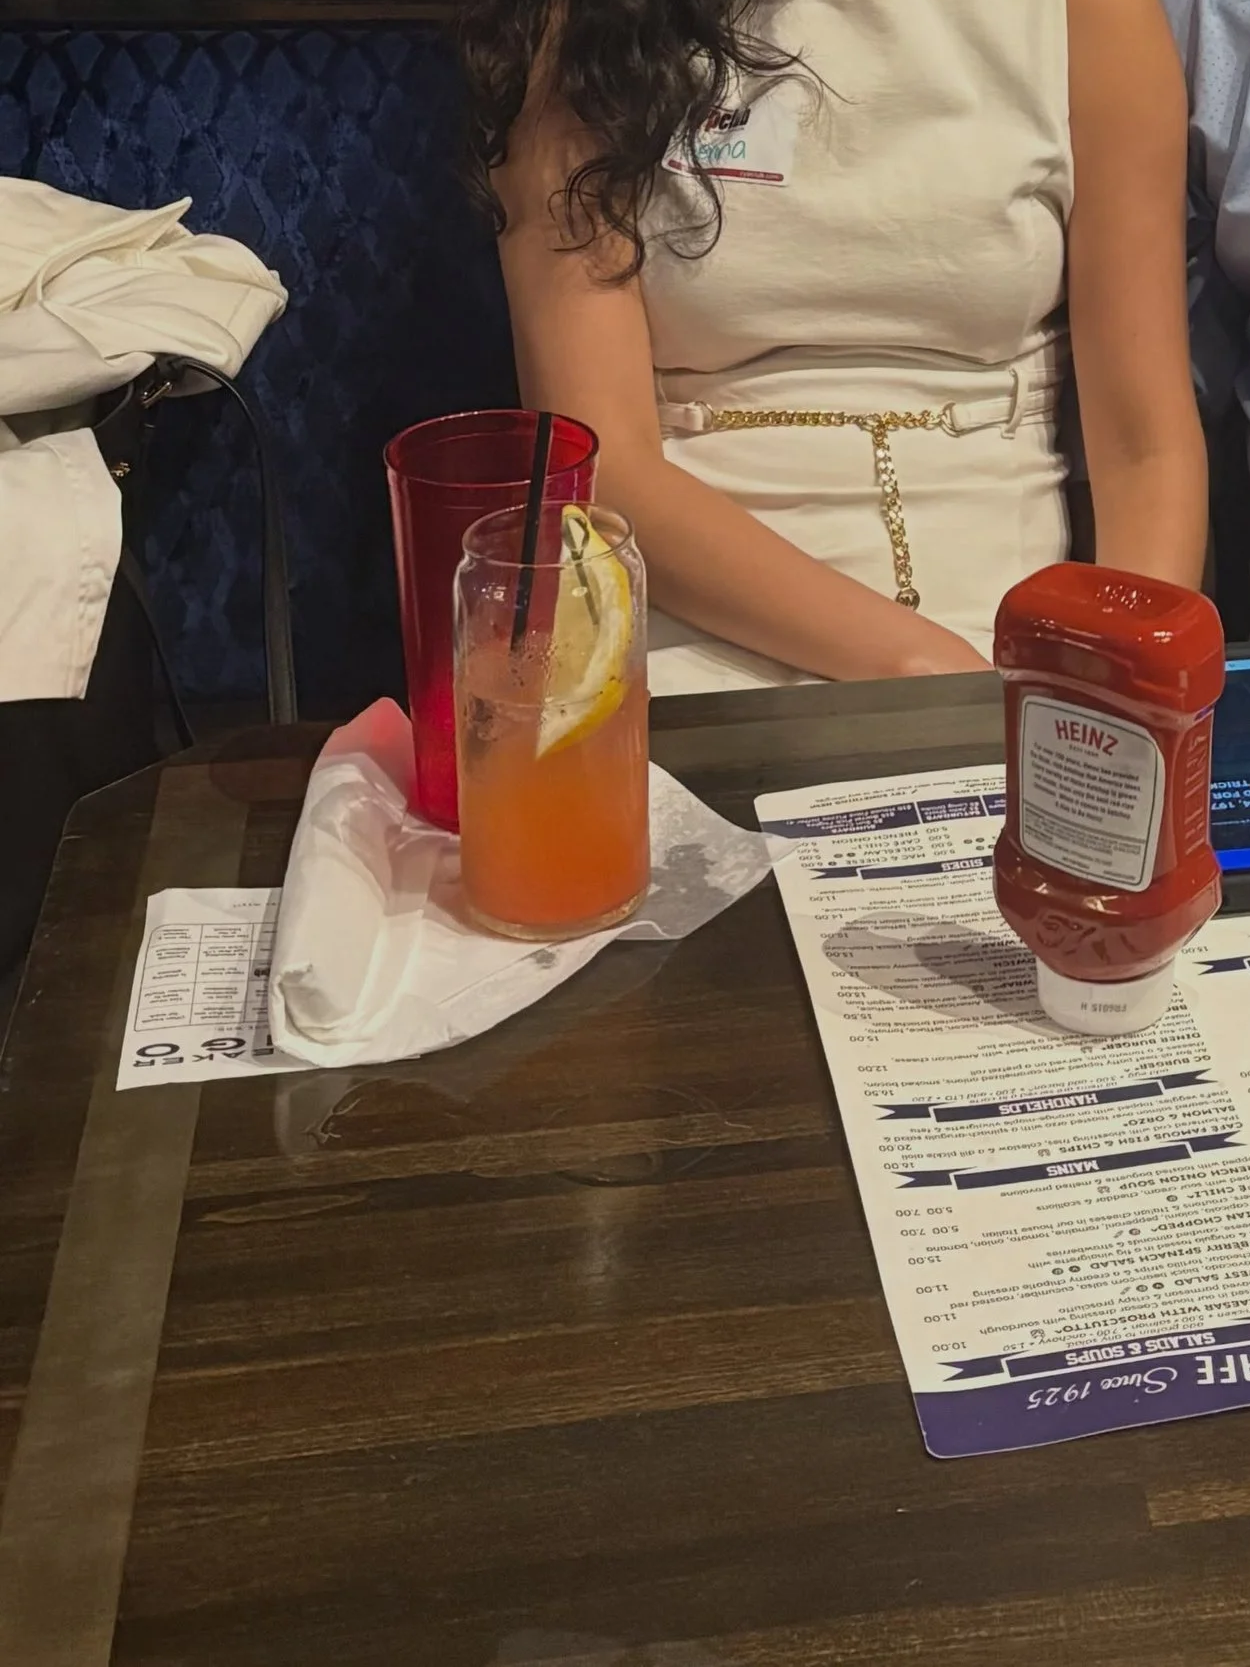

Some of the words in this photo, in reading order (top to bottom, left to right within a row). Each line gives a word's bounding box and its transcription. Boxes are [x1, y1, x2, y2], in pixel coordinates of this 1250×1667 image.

[1054, 718, 1119, 756] HEINZ
[1211, 790, 1240, 800] FOR
[940, 858, 984, 872] SIDES
[998, 1092, 1099, 1116] HANDHELDS
[1045, 1158, 1099, 1177] MAINS
[1129, 1341, 1141, 1357] &
[1143, 1330, 1216, 1353] SALADS
[1065, 1344, 1126, 1367] SOUPS
[1100, 1365, 1179, 1395] Since
[1025, 1380, 1093, 1411] 1925
